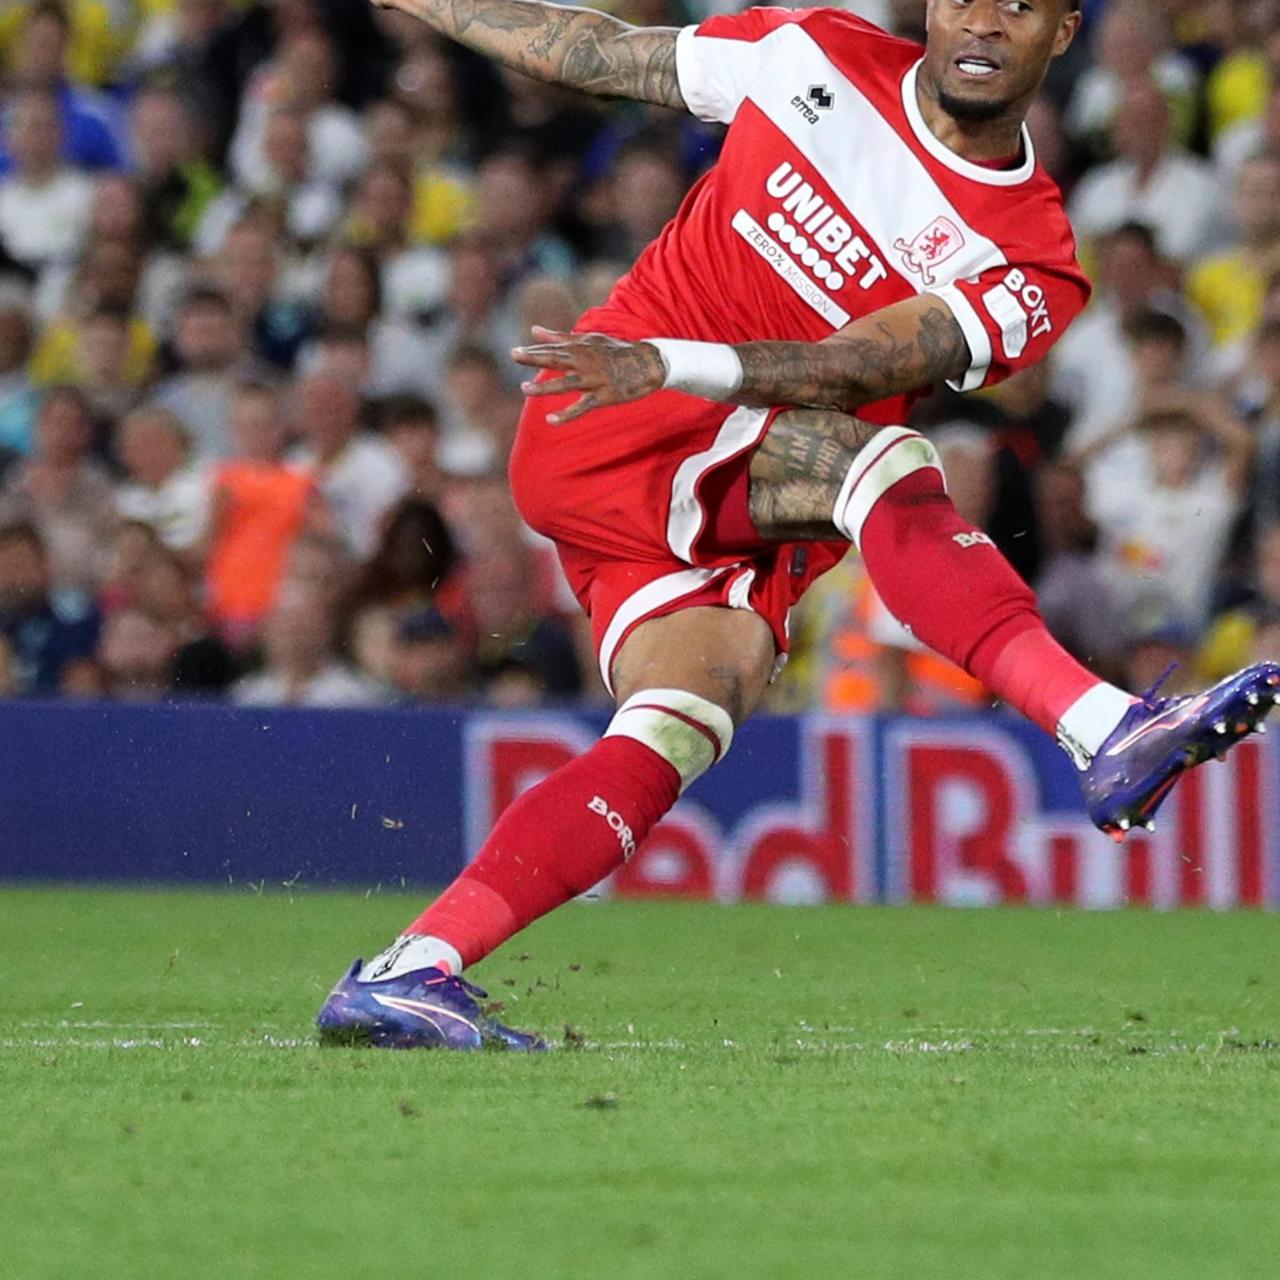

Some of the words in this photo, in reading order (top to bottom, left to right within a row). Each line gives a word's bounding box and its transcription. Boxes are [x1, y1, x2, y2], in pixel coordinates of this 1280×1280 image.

[766, 161, 888, 290] UNIBET
[746, 226, 787, 268] ZERO%
[783, 265, 831, 314] MISSION
[1003, 267, 1052, 338] BOXT
[952, 531, 998, 549] BO
[586, 795, 636, 863] BORO
